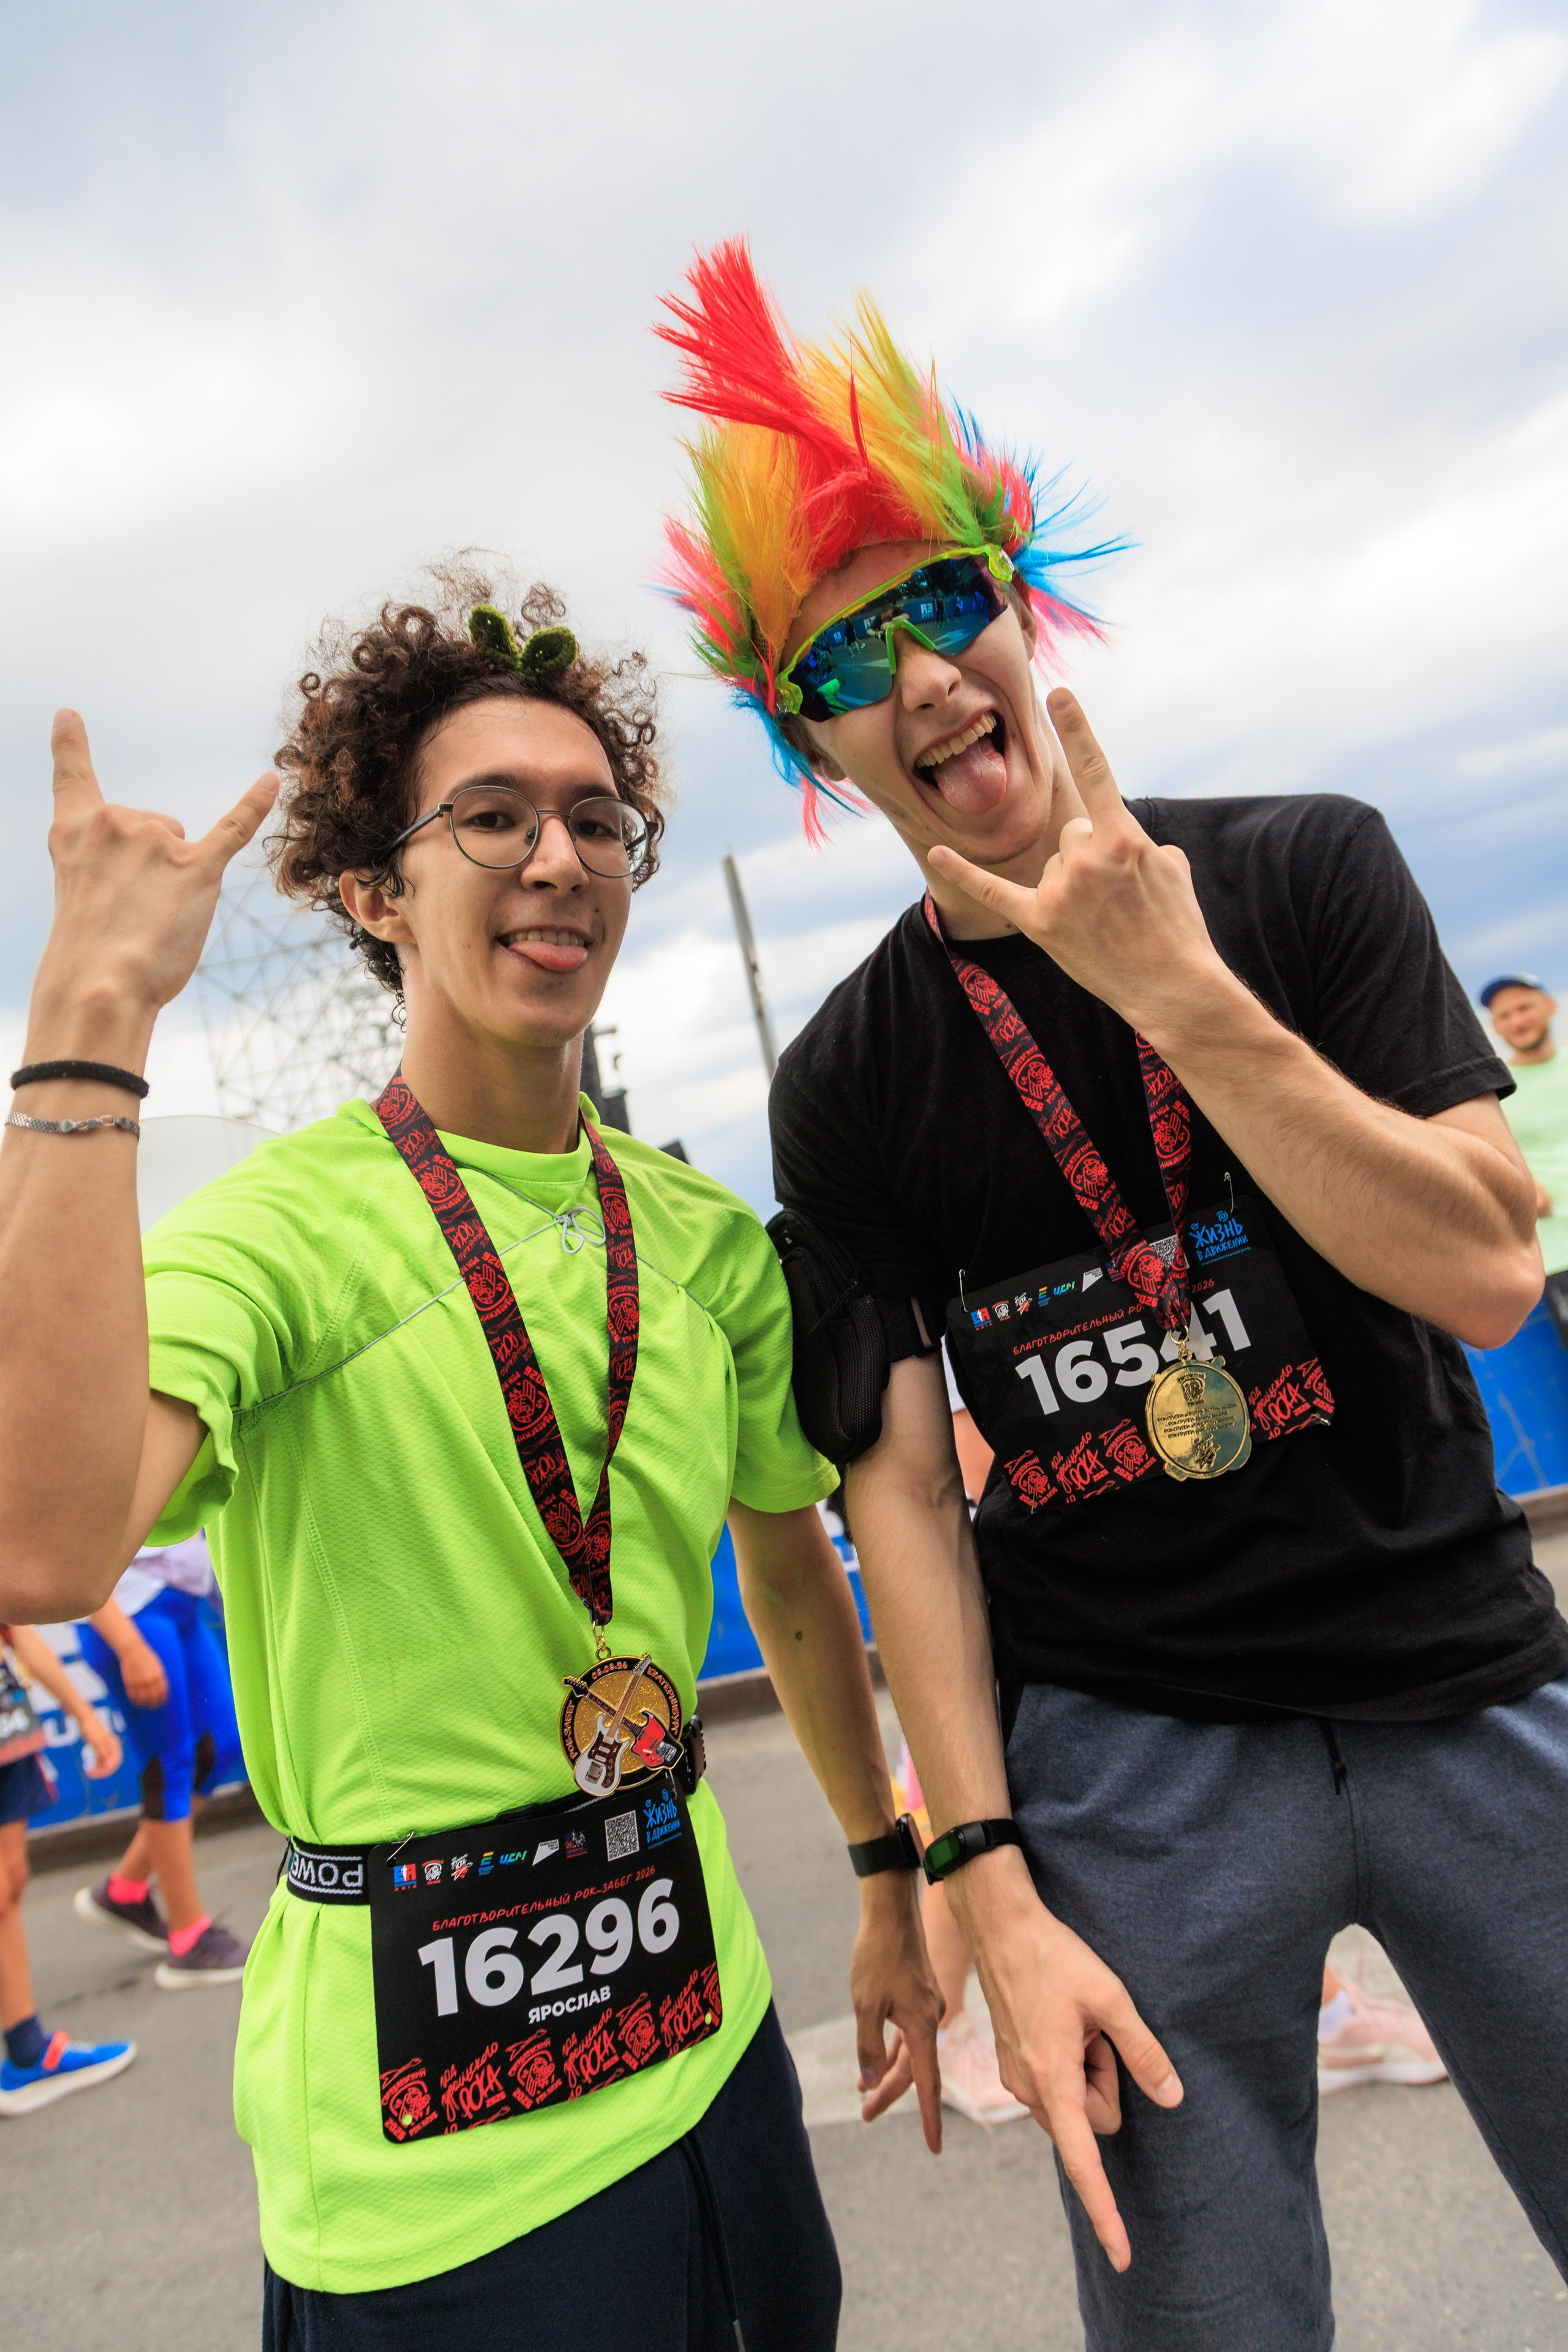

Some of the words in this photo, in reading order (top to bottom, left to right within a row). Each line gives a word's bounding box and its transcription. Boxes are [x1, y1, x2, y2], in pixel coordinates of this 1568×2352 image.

[1189, 1218, 1243, 1248] ЖИЗНЬ
[1196, 1250, 1203, 1261] В
[1205, 1234, 1248, 1258] ДВИЖЕНИИ
[1191, 1278, 1215, 1294] 2026
[1013, 1310, 1124, 1355] БЛАГОТВОРИТЕЛЬНЫЙ
[647, 1666, 679, 1735] ЕКАТЕРИНБУРГ
[564, 1700, 578, 1759] РОК-ЗАБЕГ
[643, 1798, 677, 1828] ЖИЗНЬ
[646, 1831, 650, 1843] В
[652, 1819, 680, 1841] ДВИЖЕНИИ
[432, 1893, 570, 1931] БЛАГОТВОРИТЕЛЬНЫЙ
[575, 1875, 631, 1901] РОК-ЗАБЕГ
[635, 1865, 655, 1882] 2026
[418, 1878, 680, 2018] 16296
[529, 1986, 611, 2024] ЯРОСЛАВ
